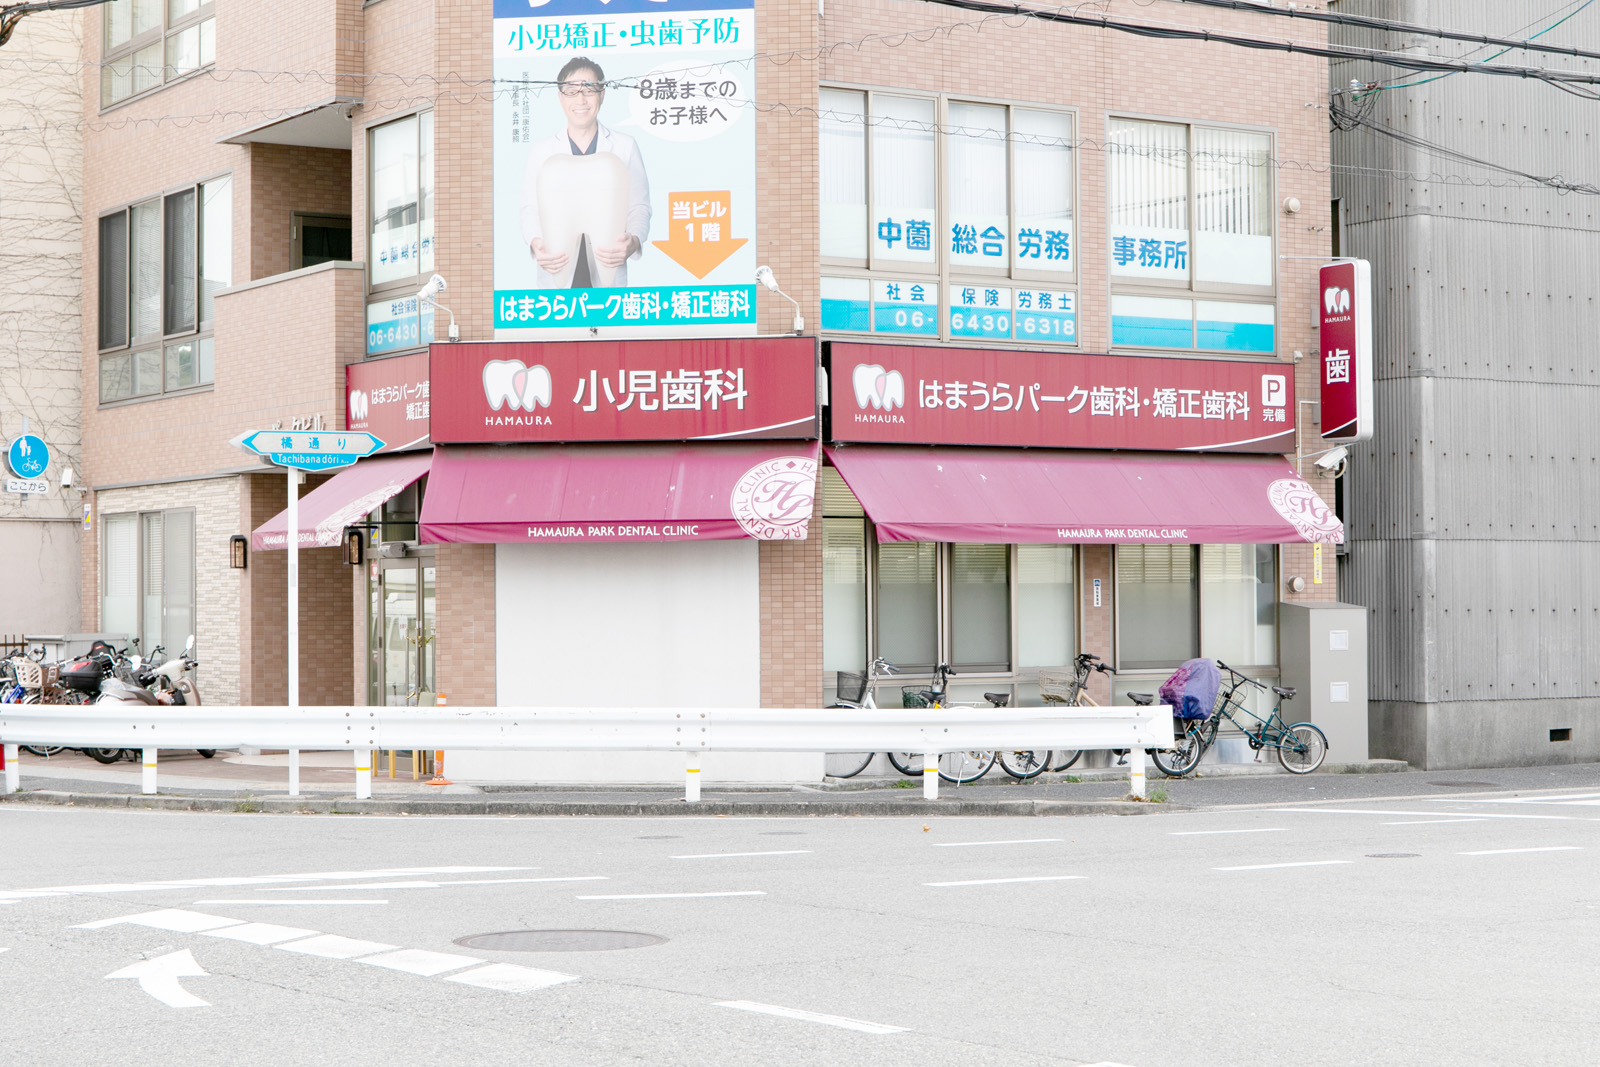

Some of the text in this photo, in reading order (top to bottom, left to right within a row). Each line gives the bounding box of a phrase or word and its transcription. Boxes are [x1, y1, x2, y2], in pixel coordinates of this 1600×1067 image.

[507, 17, 741, 52] 小児矯正・虫歯予防
[639, 78, 737, 100] 8歳までの
[649, 105, 728, 126] お子様へ
[672, 200, 727, 219] 当ビル
[684, 222, 721, 243] 1階
[951, 223, 1006, 257] 総合
[1017, 228, 1070, 261] 労務
[1112, 236, 1188, 270] 事務所
[500, 289, 751, 321] はまうらパーク歯科・矯正歯科
[886, 282, 1072, 311] 社会 保険 労務士
[951, 313, 1010, 333] 6430
[1324, 315, 1351, 324] HAMAURA
[1325, 347, 1351, 385] 歯
[572, 366, 750, 414] 小児歯科
[917, 379, 1251, 422] はまうらパーク歯科・矯正歯科
[484, 415, 553, 427] HAMAURA
[853, 413, 906, 425] HAMAURA
[1262, 408, 1286, 423] 完備
[281, 436, 346, 451] 橘通り
[9, 481, 47, 492] ここから
[739, 461, 781, 494] CLINIC
[527, 525, 699, 538] HAMAURA PARK DENTAL CLINIC
[1057, 528, 1189, 539] HAMAURA PARK DENTAL CLINIC
